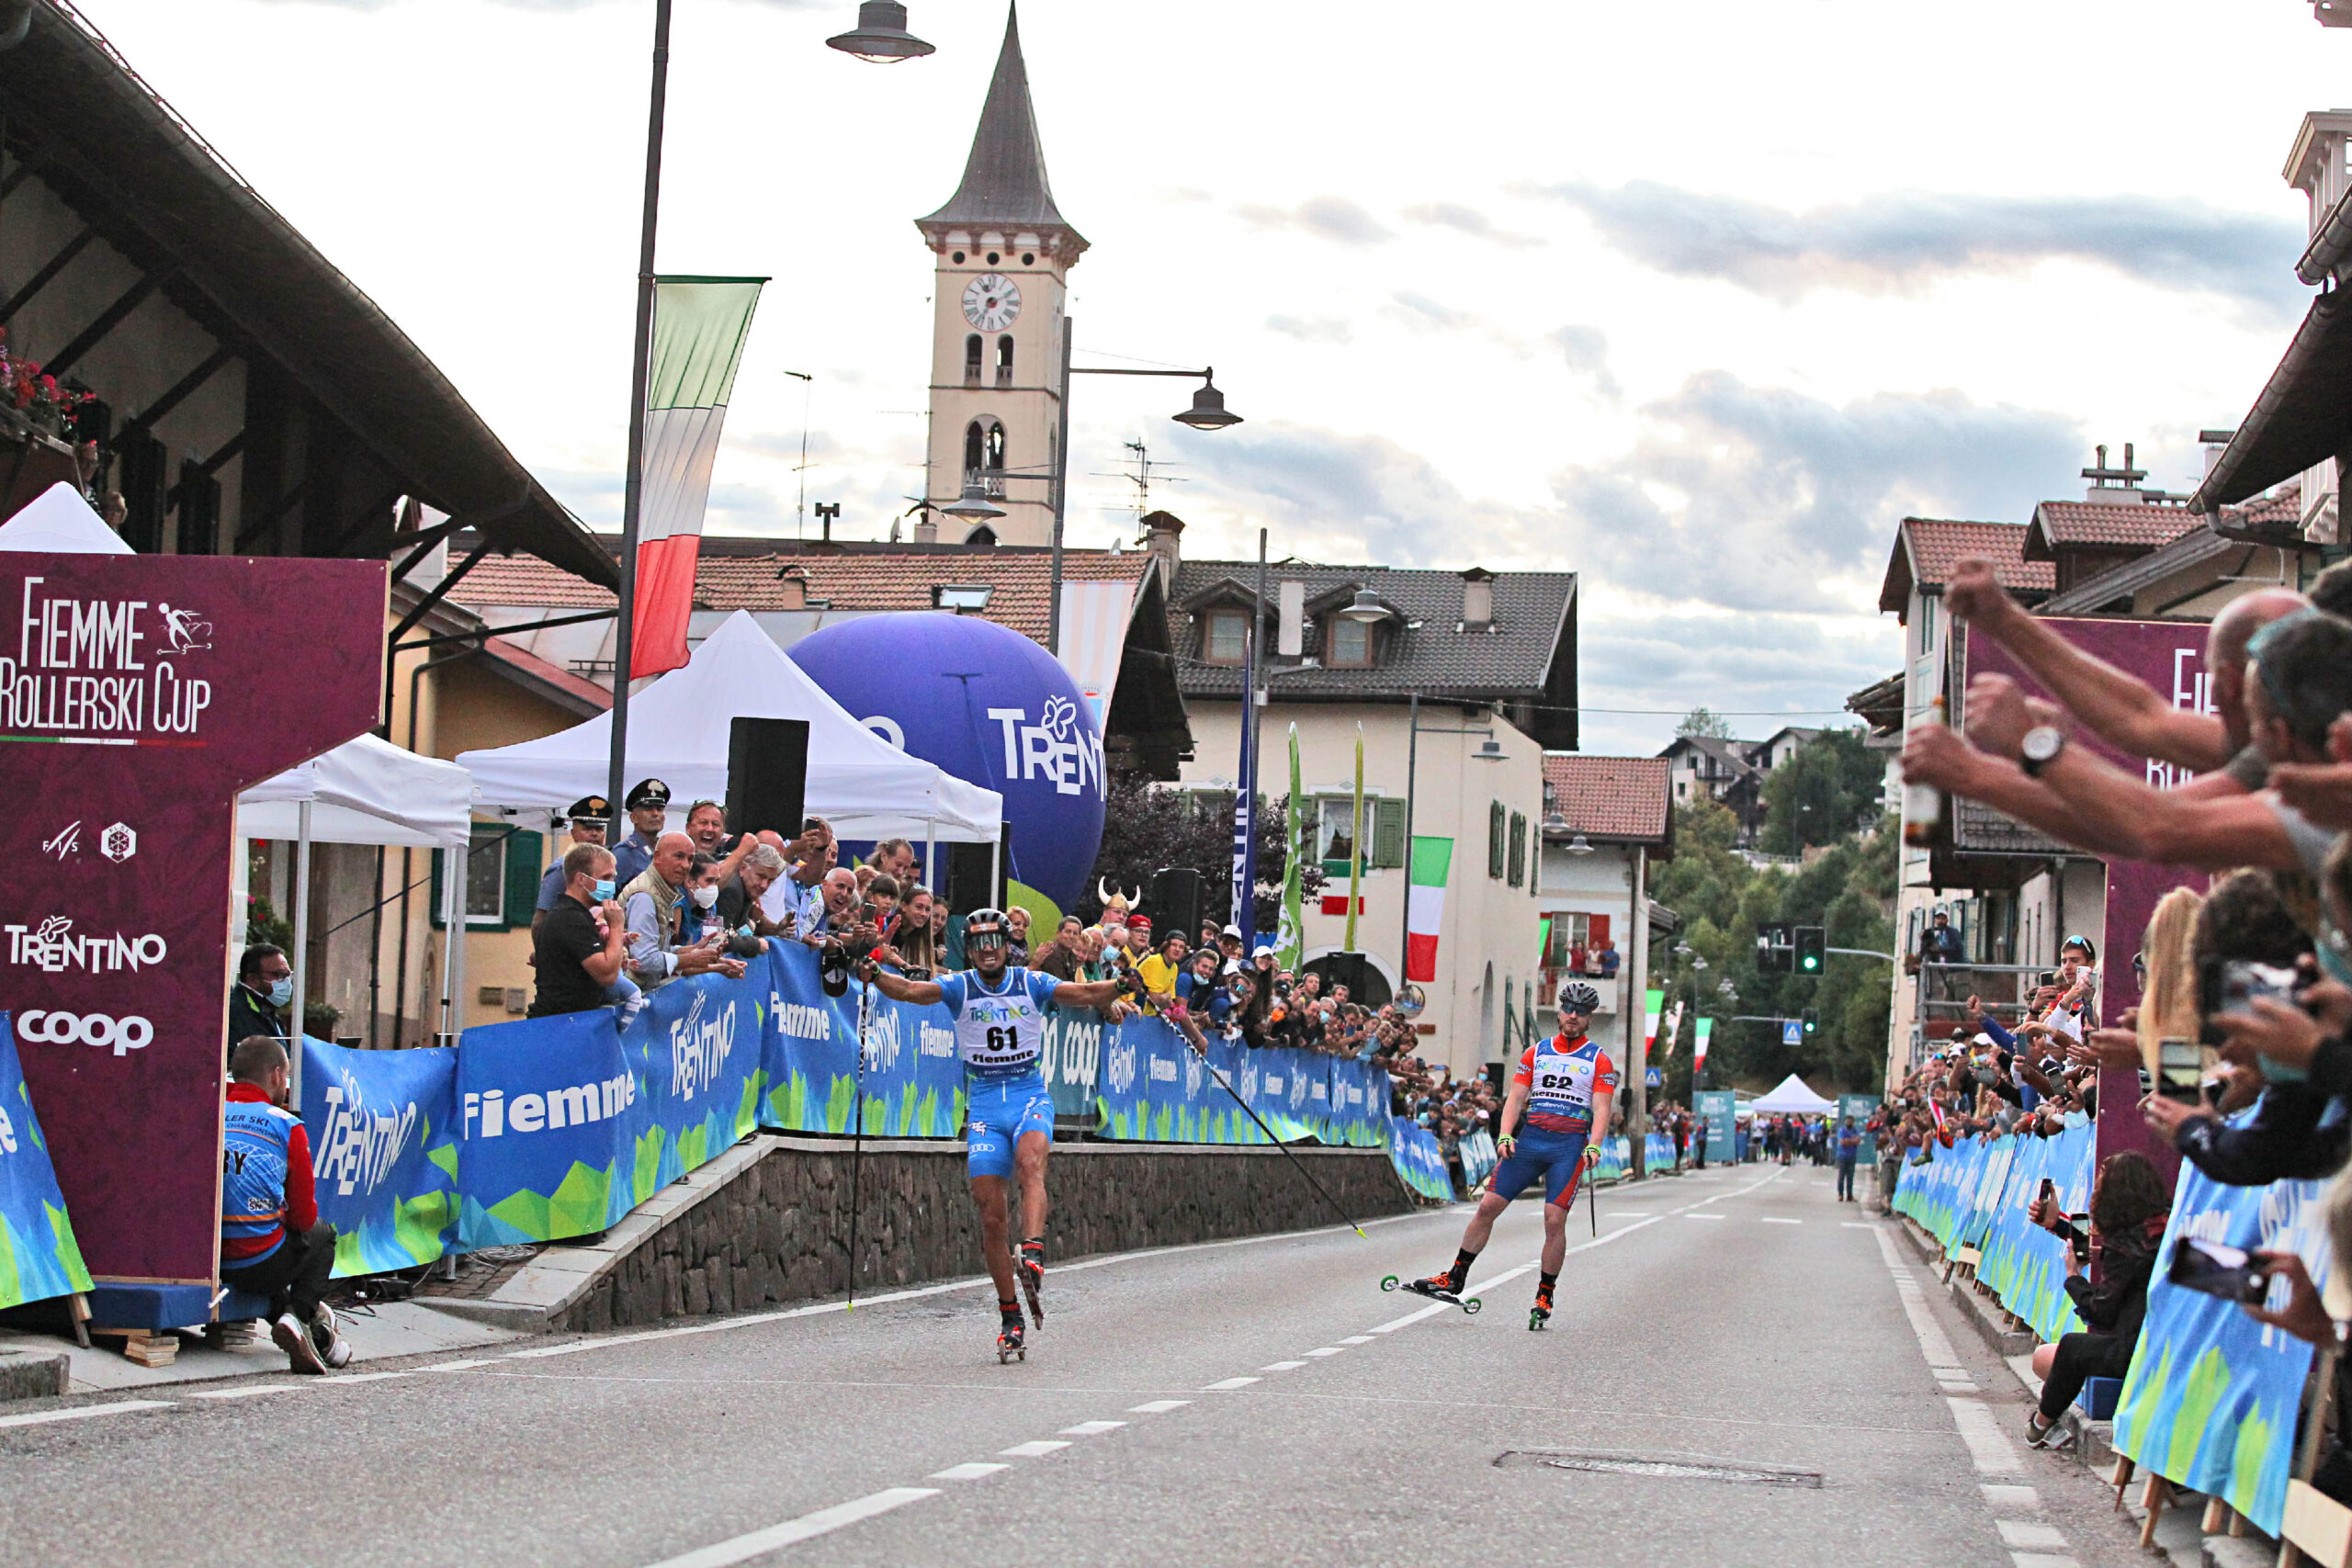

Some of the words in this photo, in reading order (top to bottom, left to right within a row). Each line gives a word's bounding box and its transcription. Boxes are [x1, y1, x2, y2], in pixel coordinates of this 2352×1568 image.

[20, 577, 148, 670] FIEMME
[0, 657, 144, 730] ROLLERSKI
[153, 661, 211, 733] CUP
[5, 924, 167, 974] TRENTINO
[17, 1010, 154, 1055] coop
[670, 999, 736, 1101] TRENTINO
[987, 1026, 1018, 1052] 61
[1542, 1074, 1573, 1090] 62
[249, 1115, 270, 1127] SKI
[314, 1087, 417, 1195] TRENTINO
